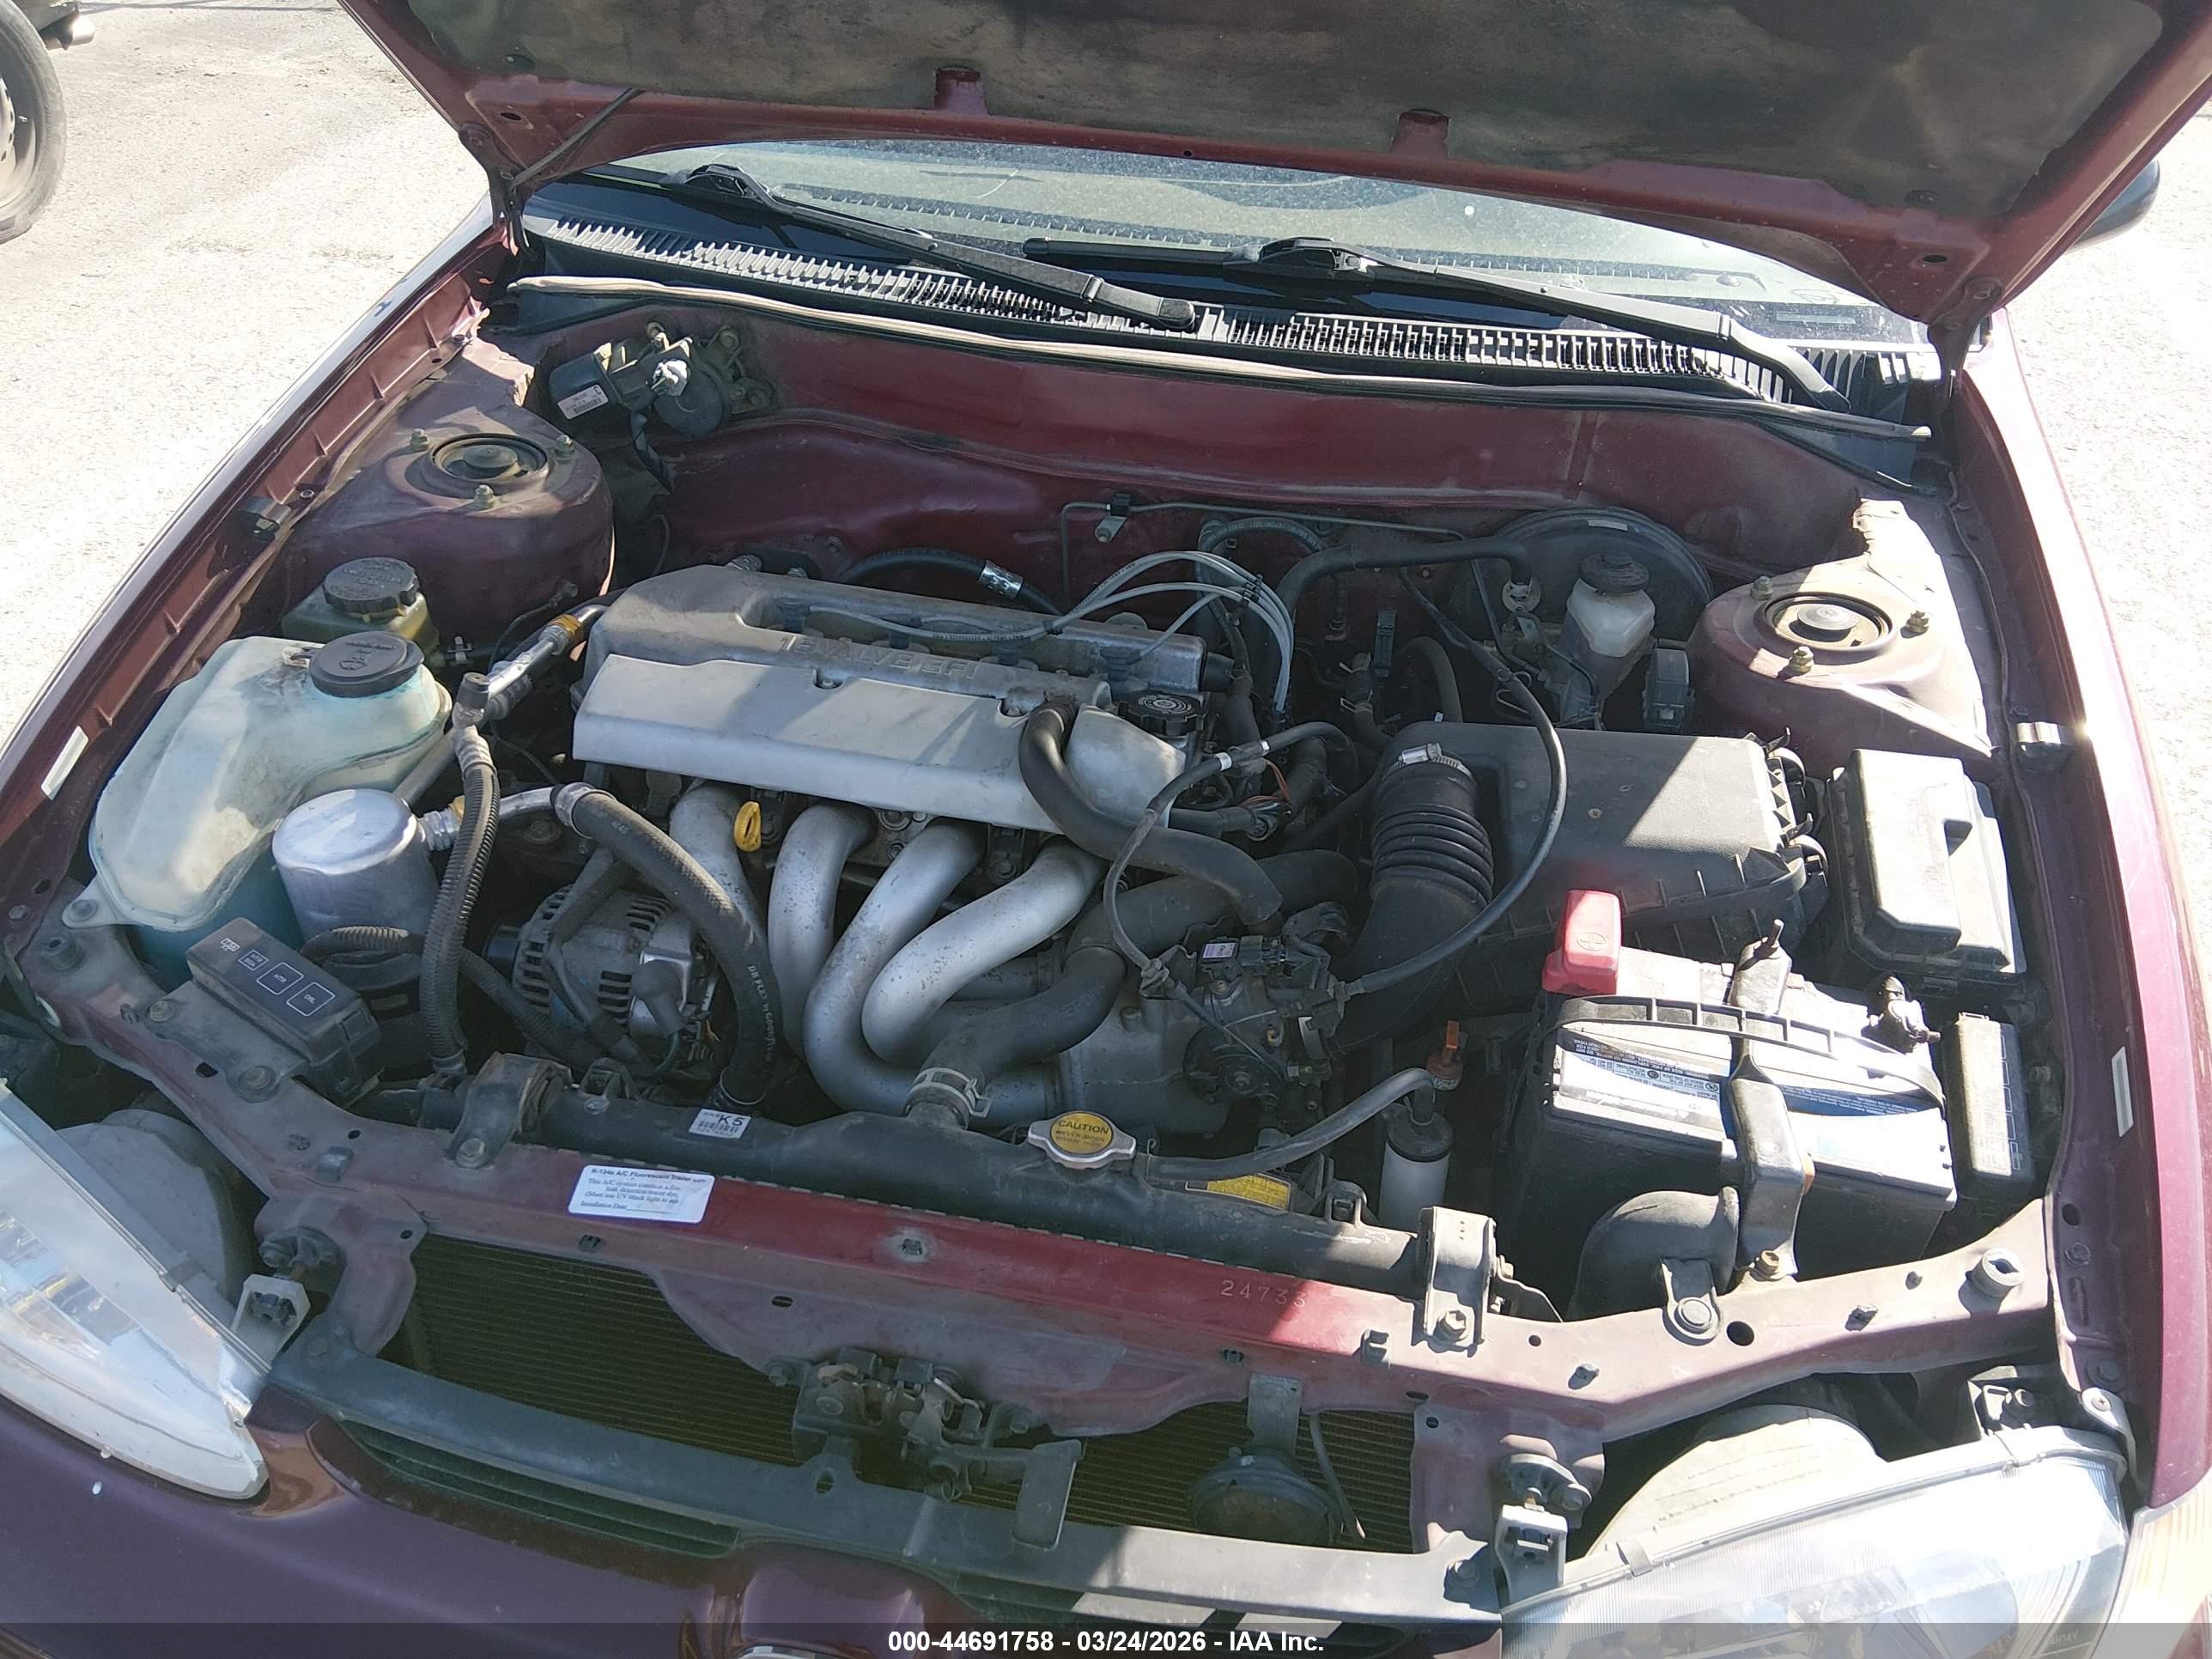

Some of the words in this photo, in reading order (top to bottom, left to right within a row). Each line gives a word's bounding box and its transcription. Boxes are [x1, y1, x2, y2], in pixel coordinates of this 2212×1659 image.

[718, 1115, 744, 1127] K5
[1057, 1120, 1109, 1134] CAUTION
[629, 1171, 670, 1180] Fluorescent
[1220, 1279, 1308, 1307] 24733
